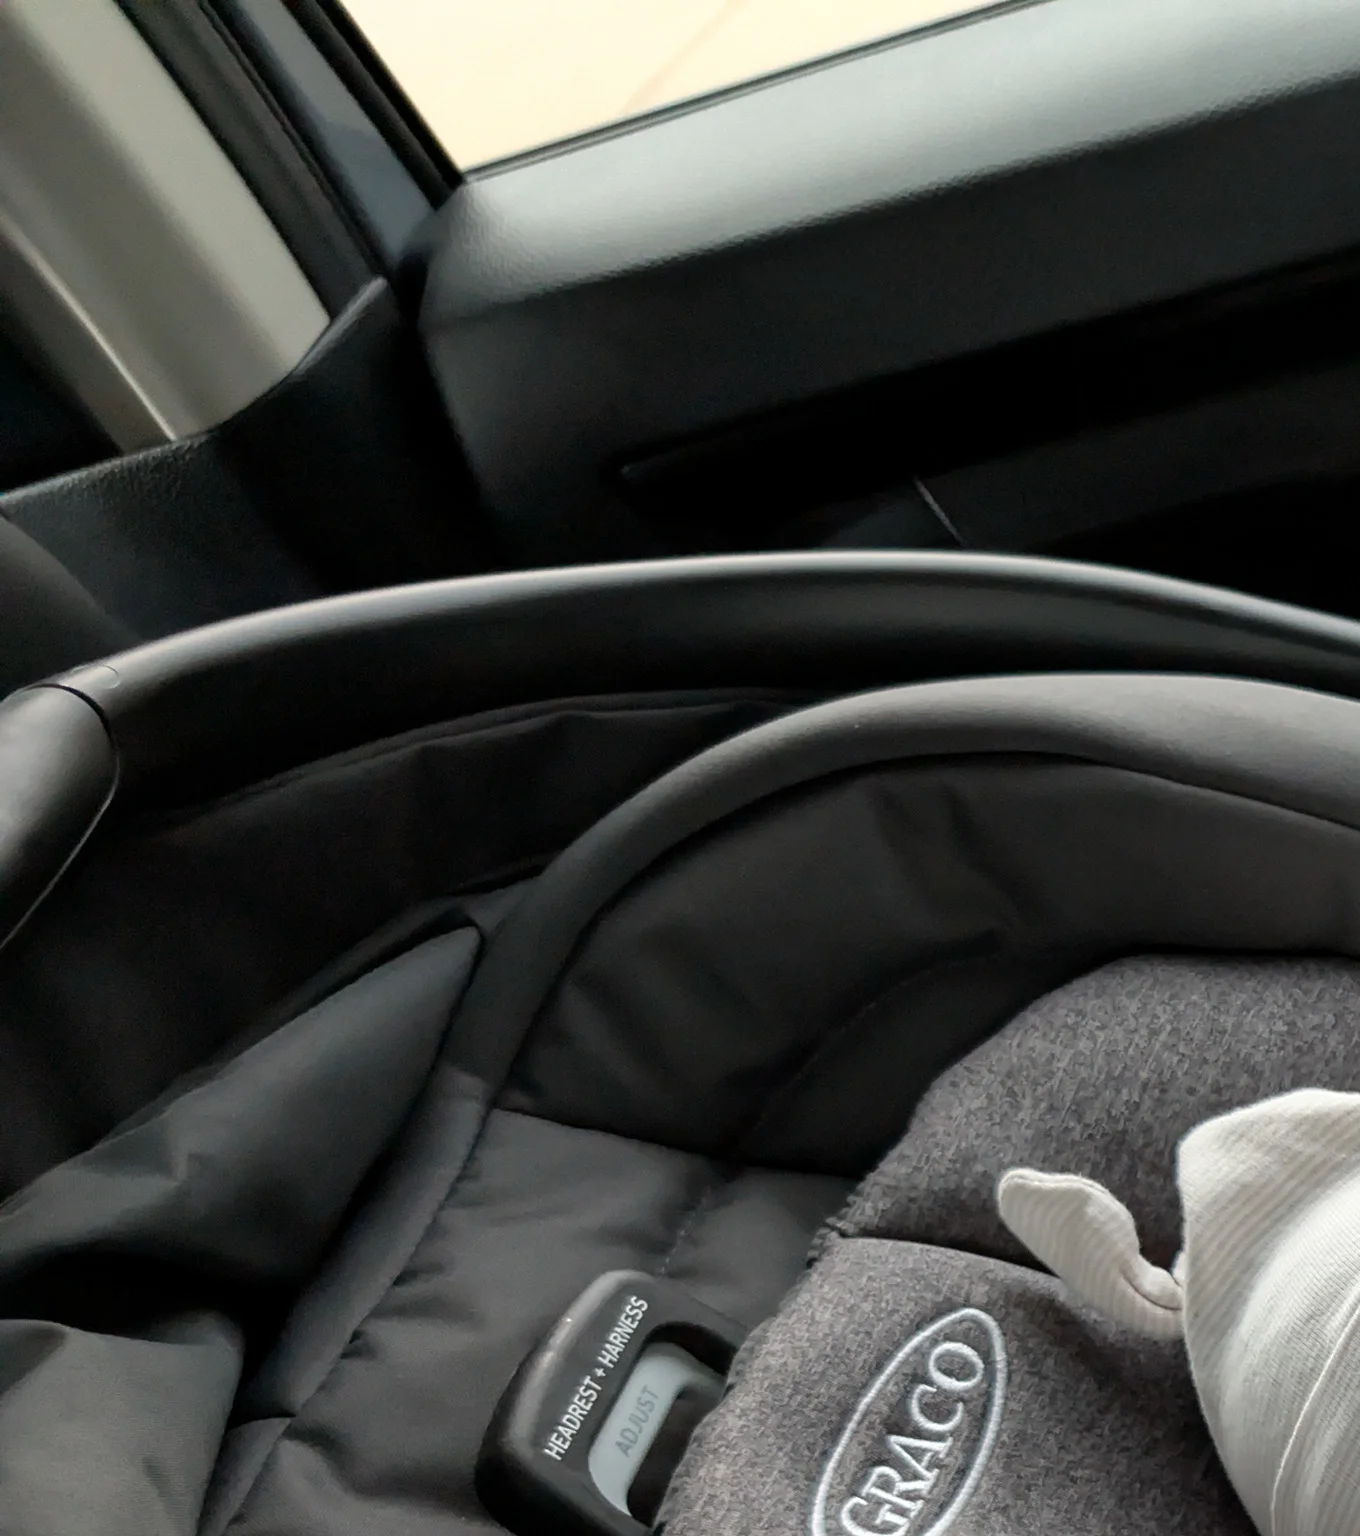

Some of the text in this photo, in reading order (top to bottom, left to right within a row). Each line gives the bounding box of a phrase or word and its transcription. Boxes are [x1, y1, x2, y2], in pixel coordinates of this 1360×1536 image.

[544, 1296, 648, 1460] HEADREST + HARNESS
[615, 1385, 659, 1458] ADJUST
